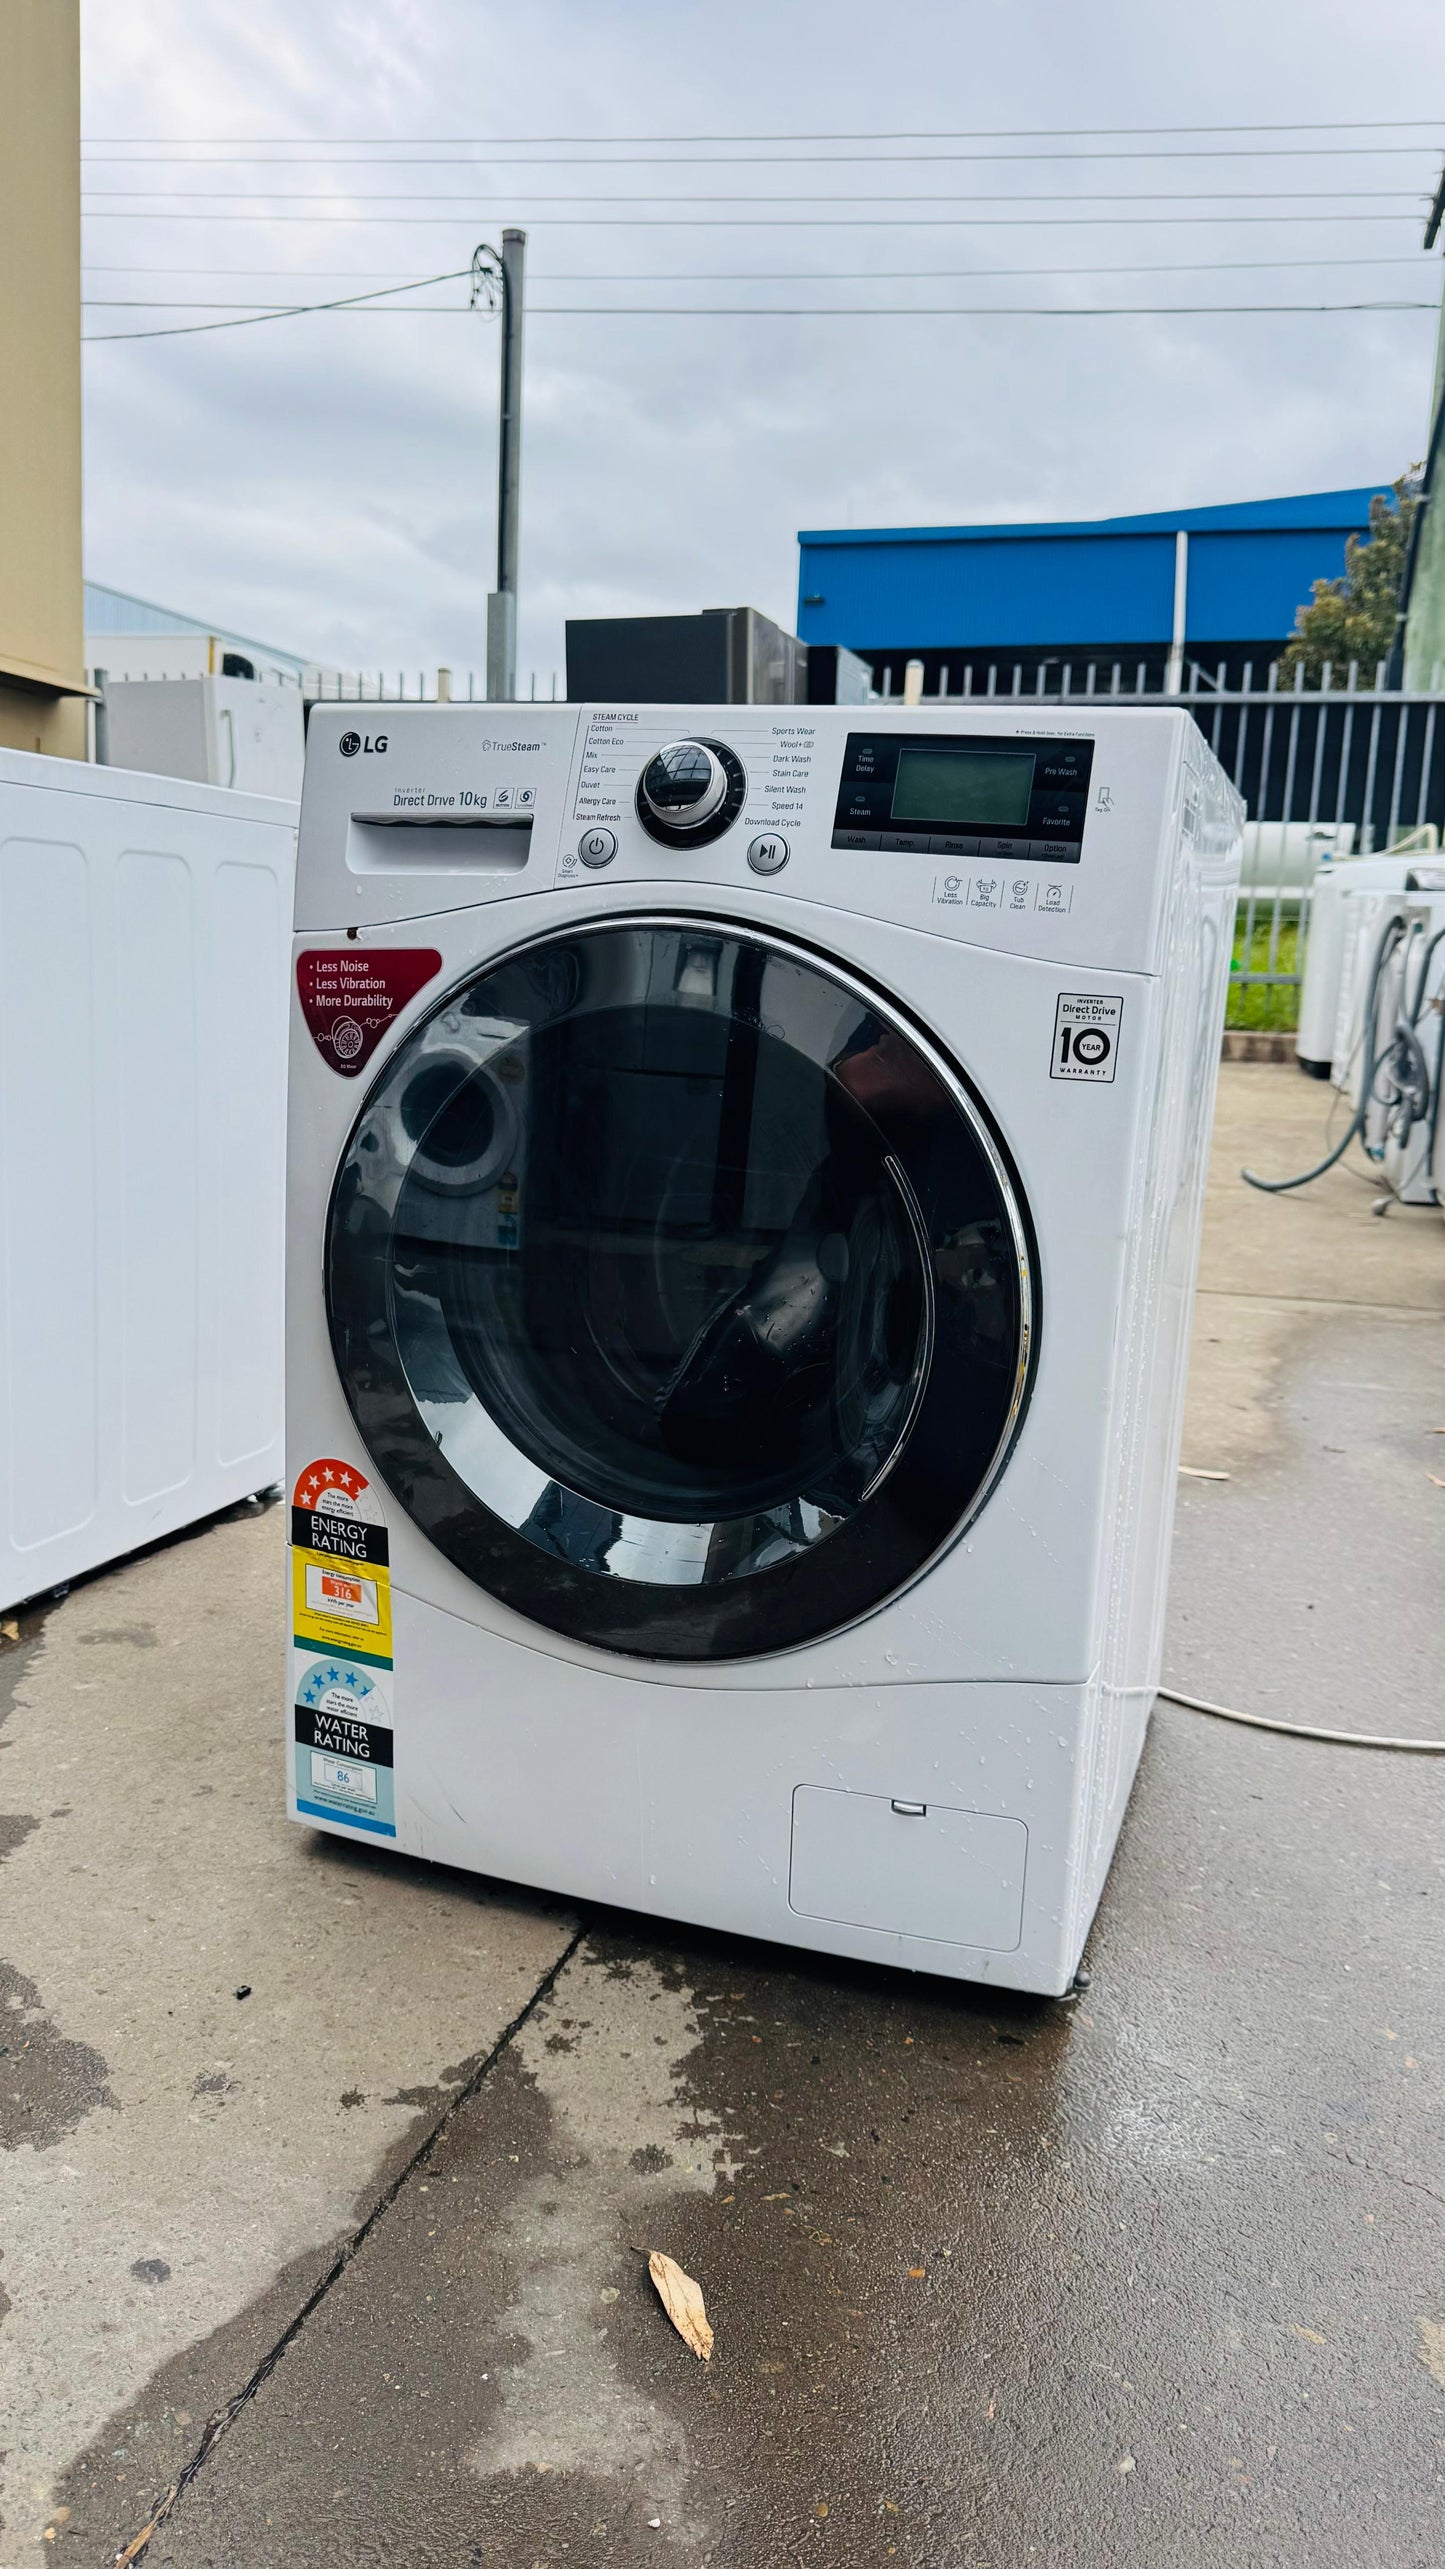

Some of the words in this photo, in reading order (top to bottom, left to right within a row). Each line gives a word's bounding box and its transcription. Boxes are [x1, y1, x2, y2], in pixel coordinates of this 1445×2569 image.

[592, 713, 617, 721] STEAM
[617, 713, 639, 721] CYCLE
[771, 727, 795, 736] Sports
[363, 735, 389, 754] LG
[772, 755, 790, 763] Dark
[584, 766, 599, 774] Easy
[772, 770, 790, 778] Stain
[792, 770, 808, 778] Care
[856, 765, 875, 774] Delay
[1045, 768, 1056, 776] Pre
[1058, 768, 1078, 776] Wash
[393, 795, 425, 806] Direct
[427, 795, 455, 806] Drive
[579, 798, 601, 806] Allergy
[772, 802, 794, 810] Speed
[850, 808, 871, 816] Steam
[596, 814, 621, 822] Refresh
[1042, 818, 1070, 826] Favorite
[744, 818, 780, 826] Download
[781, 818, 801, 828] Cycle
[848, 835, 866, 844] Wash
[1044, 844, 1066, 854] Option
[937, 897, 963, 906] Vibration
[970, 900, 996, 908] Capacity
[1038, 905, 1066, 913] Detection
[316, 960, 338, 972] Less
[340, 960, 369, 972] Noise
[316, 978, 338, 990] Less
[340, 977, 386, 989] Vibration
[316, 994, 341, 1006] More
[344, 994, 394, 1010] Durability
[1062, 1004, 1090, 1014] Direct
[1092, 1006, 1116, 1016] Drive
[1060, 1027, 1110, 1066] 10
[1060, 1068, 1106, 1076] WARRANTY
[322, 1505, 336, 1514] energy
[336, 1508, 354, 1516] efficient
[311, 1515, 368, 1541] ENERGY
[312, 1532, 367, 1558] RATING
[334, 1586, 352, 1600] 316
[332, 1692, 340, 1700] The
[326, 1698, 336, 1706] stars
[340, 1708, 358, 1718] efficient
[314, 1713, 368, 1742] WATER
[314, 1730, 370, 1758] RATING
[337, 1770, 350, 1784] 86
